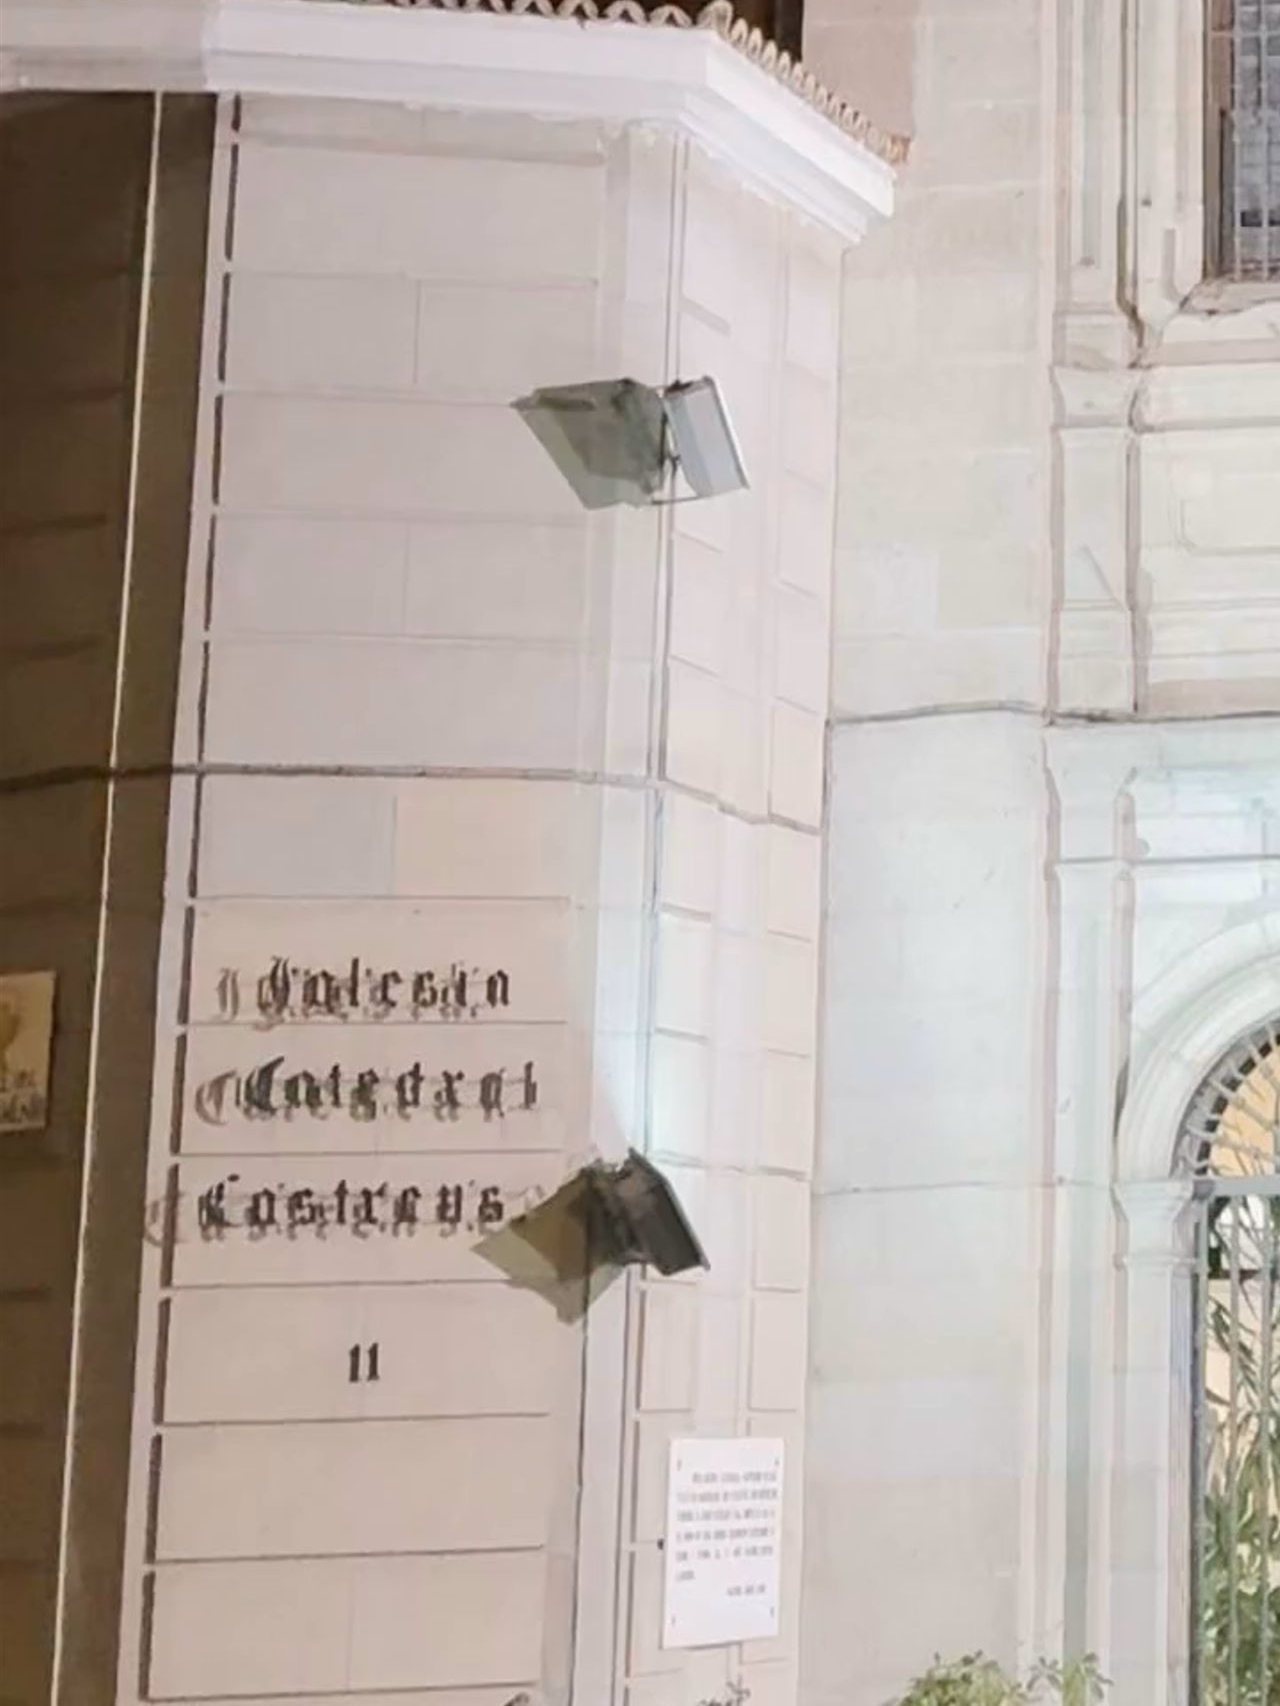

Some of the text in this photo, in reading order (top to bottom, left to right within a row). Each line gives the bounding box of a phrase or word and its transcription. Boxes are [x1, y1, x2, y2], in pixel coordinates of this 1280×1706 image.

[243, 1055, 539, 1117] Catedral
[198, 1173, 528, 1228] Castrens
[349, 1343, 380, 1383] 11
